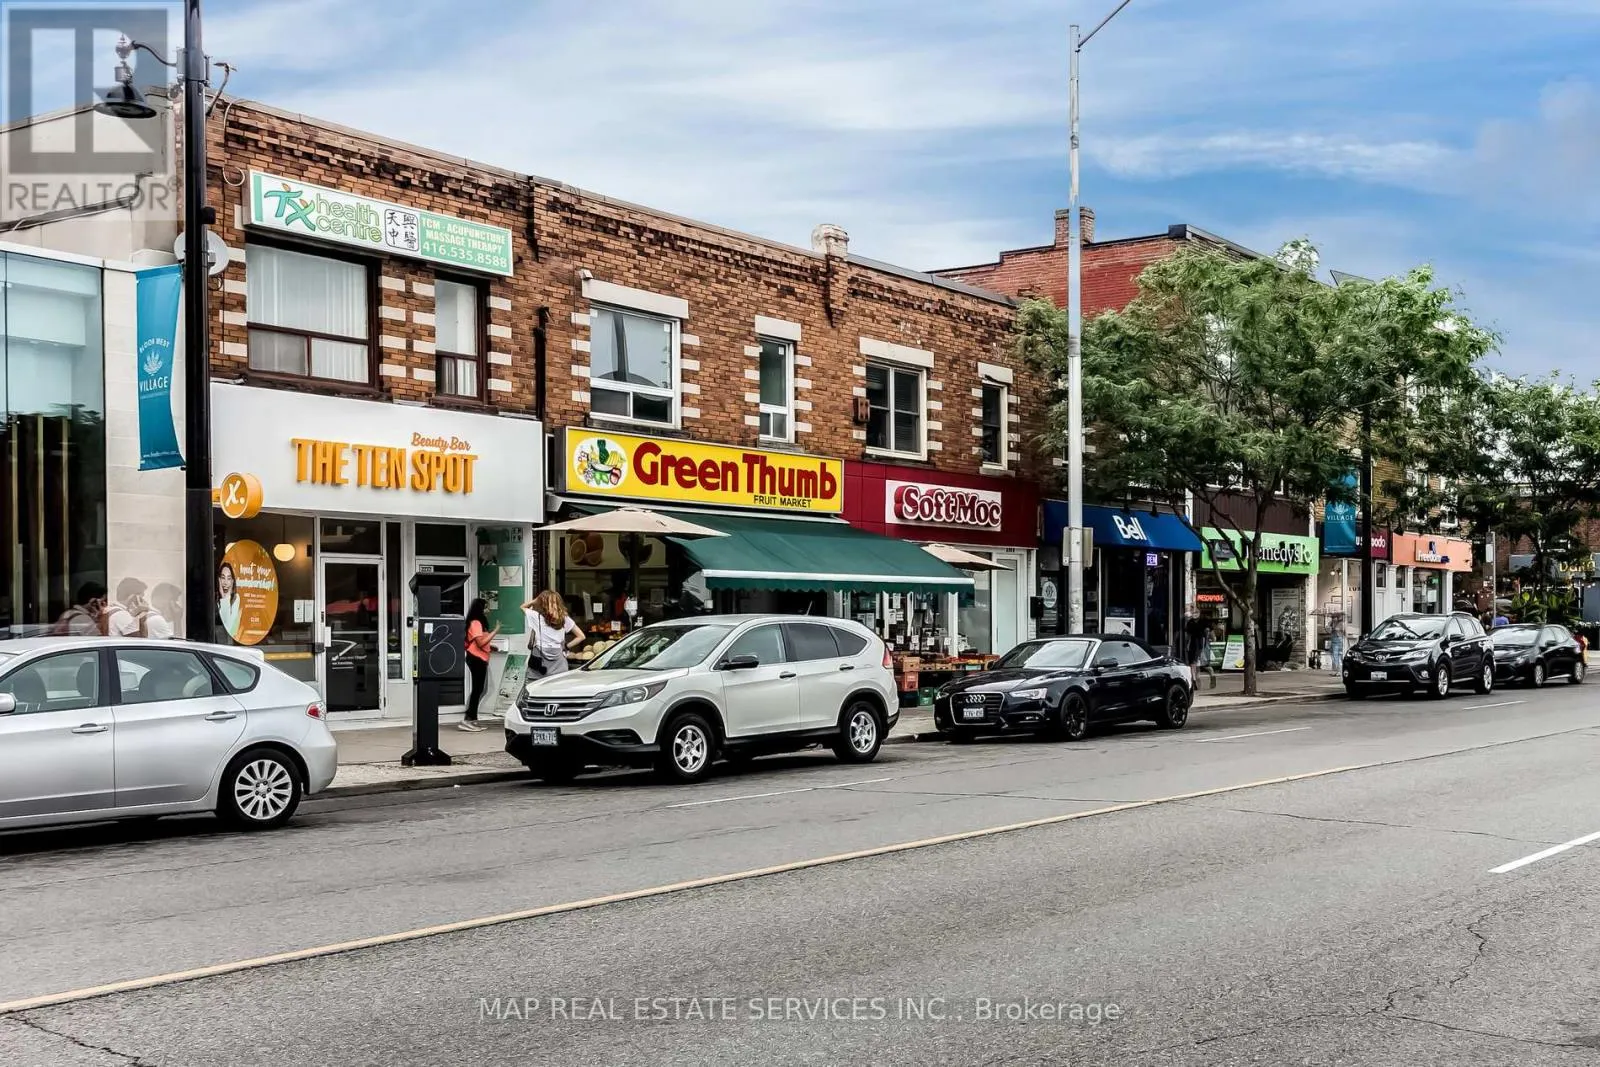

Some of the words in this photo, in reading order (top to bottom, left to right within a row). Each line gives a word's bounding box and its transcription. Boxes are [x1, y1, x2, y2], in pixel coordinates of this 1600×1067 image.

[316, 193, 380, 227] health
[316, 215, 382, 243] centre
[422, 217, 441, 230] TCM
[447, 223, 506, 245] ACUPUNCTURE
[425, 229, 466, 247] MASSAGE
[467, 239, 503, 255] THERAPY
[422, 241, 508, 268] 416.535.8588
[139, 375, 169, 392] VILLAGE
[411, 431, 449, 455] Beauty
[449, 436, 472, 452] Bar
[291, 437, 350, 485] THE
[352, 443, 407, 490] TEN
[410, 449, 479, 496] SPOT
[753, 494, 778, 506] FRUIT
[779, 496, 812, 509] MARKET
[894, 485, 1001, 528] SoftMoc
[1111, 514, 1148, 541] Bell
